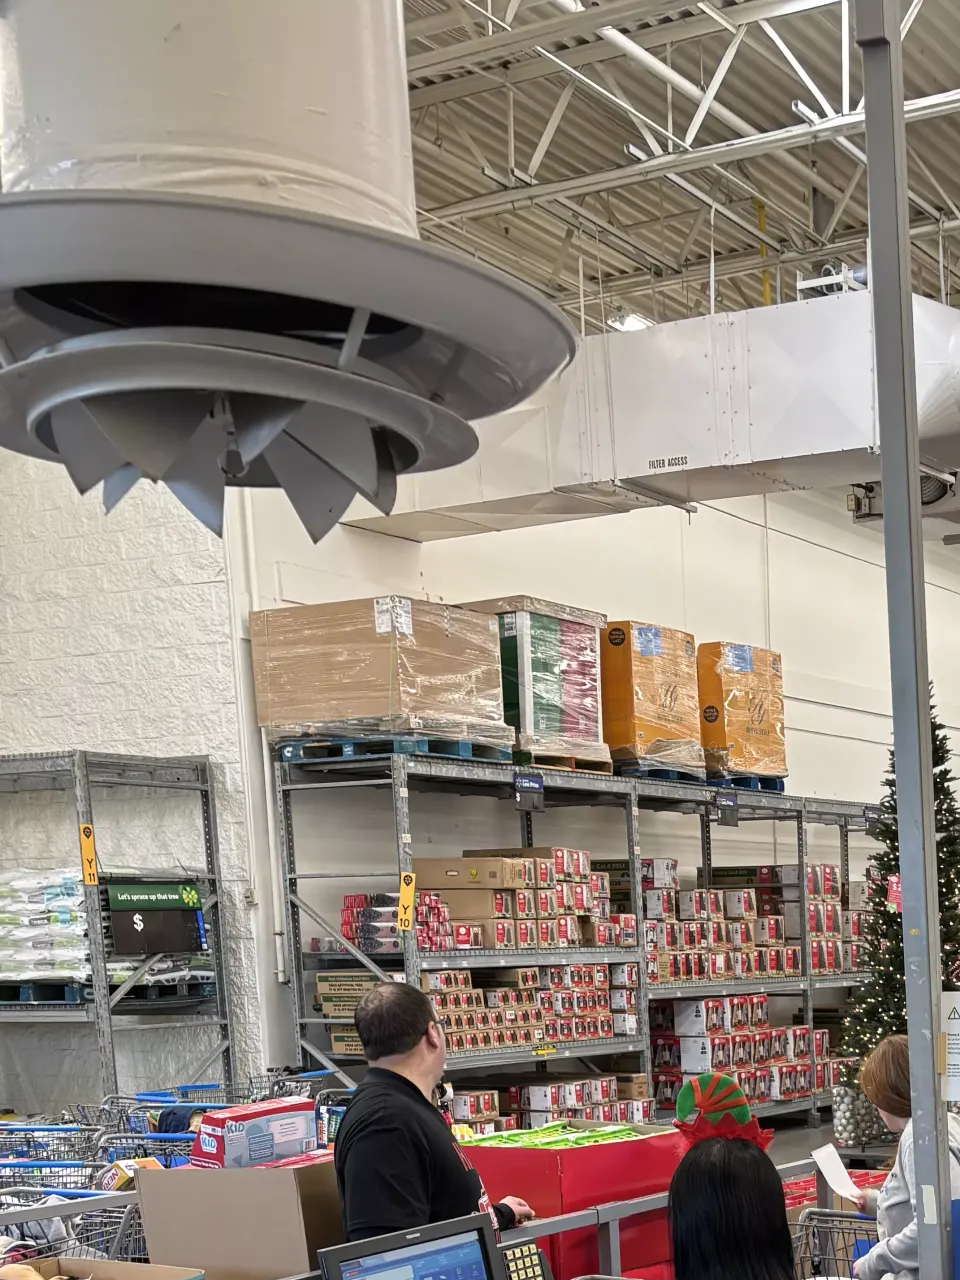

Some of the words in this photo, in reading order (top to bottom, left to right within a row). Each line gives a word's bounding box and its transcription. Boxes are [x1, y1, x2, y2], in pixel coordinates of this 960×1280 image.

[649, 459, 665, 469] FILTER
[668, 456, 688, 467] ACCESS
[87, 858, 94, 869] Y
[88, 873, 95, 882] 11
[402, 905, 410, 915] Y
[133, 913, 144, 932] $
[400, 918, 410, 928] 10
[226, 1121, 244, 1134] KID
[201, 1136, 216, 1149] KID
